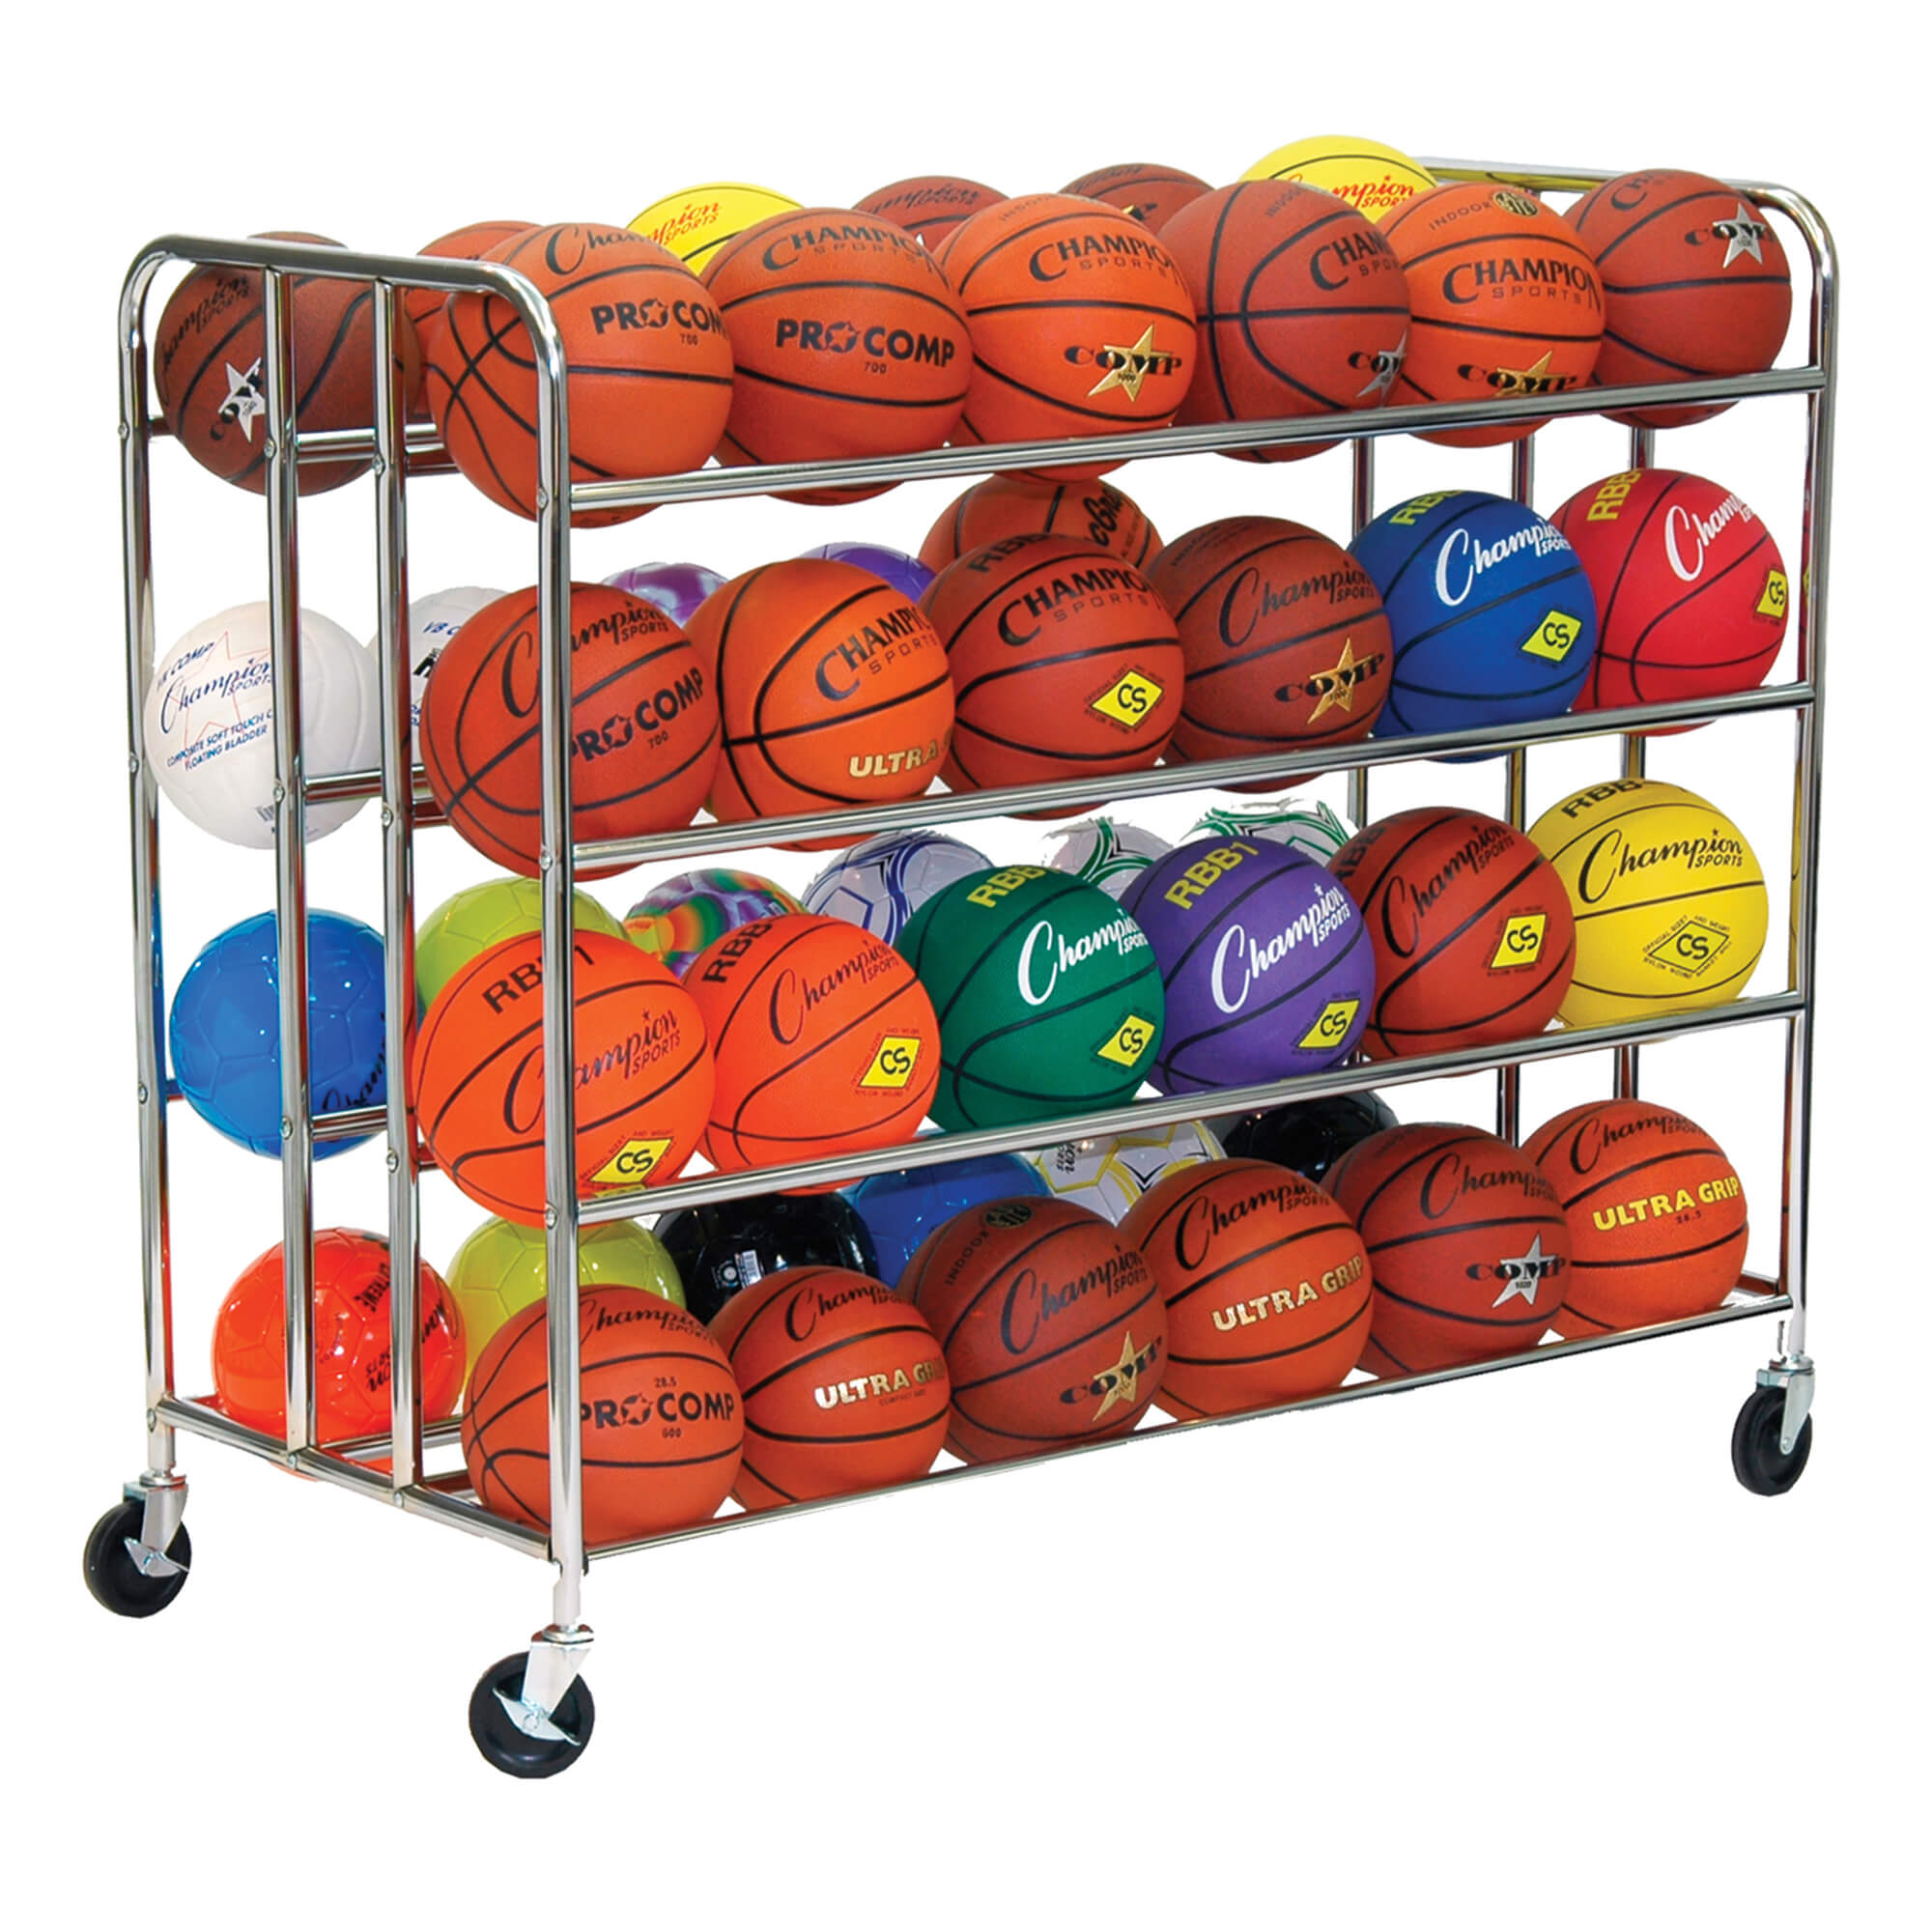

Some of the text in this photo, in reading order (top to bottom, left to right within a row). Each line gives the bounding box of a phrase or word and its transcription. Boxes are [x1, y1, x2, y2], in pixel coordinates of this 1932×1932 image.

[1333, 176, 1413, 209] mpion
[666, 213, 719, 243] SPORTS
[1430, 201, 1492, 232] INDOOR
[1079, 253, 1167, 278] SPORTS
[1310, 231, 1391, 291] CHAM
[1360, 259, 1401, 277] SPO
[1442, 258, 1602, 317] CHAMPION
[1492, 285, 1582, 305] SPORTS
[672, 299, 730, 341] COM
[680, 333, 698, 346] 700
[865, 361, 888, 375] 700
[1065, 345, 1182, 377] COMP
[1348, 352, 1403, 373] COM
[210, 365, 264, 441] COM
[1586, 469, 1644, 523] RBB
[1053, 591, 1150, 623] SPORTS
[1218, 560, 1373, 648] Champion
[1768, 580, 1786, 608] CS
[619, 621, 668, 642] SPORTS
[1543, 622, 1572, 650] CS
[815, 606, 932, 701] CHAMPIO
[869, 632, 939, 675] SPORTS
[1275, 653, 1385, 703] COMP
[1117, 683, 1148, 714] CS
[206, 727, 229, 748] SOFT
[231, 713, 265, 736] TOUCH
[646, 730, 670, 750] 700
[848, 740, 940, 778] ULTRA
[1561, 780, 1643, 819] RBB
[1477, 836, 1516, 869] SPORTS
[1577, 828, 1743, 904] Champion
[1695, 854, 1744, 868] SPORTS
[967, 867, 1061, 908] RBB
[1164, 840, 1259, 910] RBB1
[1381, 826, 1508, 959] Champion
[1318, 902, 1350, 943] SPORTS
[1506, 924, 1539, 953] CS
[702, 922, 773, 983] RBB
[1211, 882, 1345, 1014] Champion
[1676, 933, 1710, 960] CS
[482, 945, 595, 1014] RB1
[1119, 1027, 1144, 1055] CS
[1320, 1009, 1348, 1037] CS
[632, 1030, 681, 1075] SPORTS
[879, 1046, 911, 1075] CS
[503, 1008, 678, 1134] Campion
[615, 1149, 654, 1174] CS
[1286, 1196, 1330, 1211] SPORTS
[1420, 1151, 1549, 1220] Champ
[1592, 1188, 1697, 1232] ULTRA
[1698, 1175, 1740, 1205] GRIP
[944, 1229, 991, 1288] INDOOR
[1465, 1256, 1566, 1282] COMP
[1113, 1266, 1149, 1293] SPORTS
[1210, 1255, 1364, 1332] ULTRA GRIP
[784, 1284, 903, 1342] Champ
[1000, 1243, 1143, 1355] Champion
[654, 1377, 677, 1388] 28.5
[814, 1355, 946, 1410] ULTRA GR
[1060, 1336, 1163, 1406] COMP
